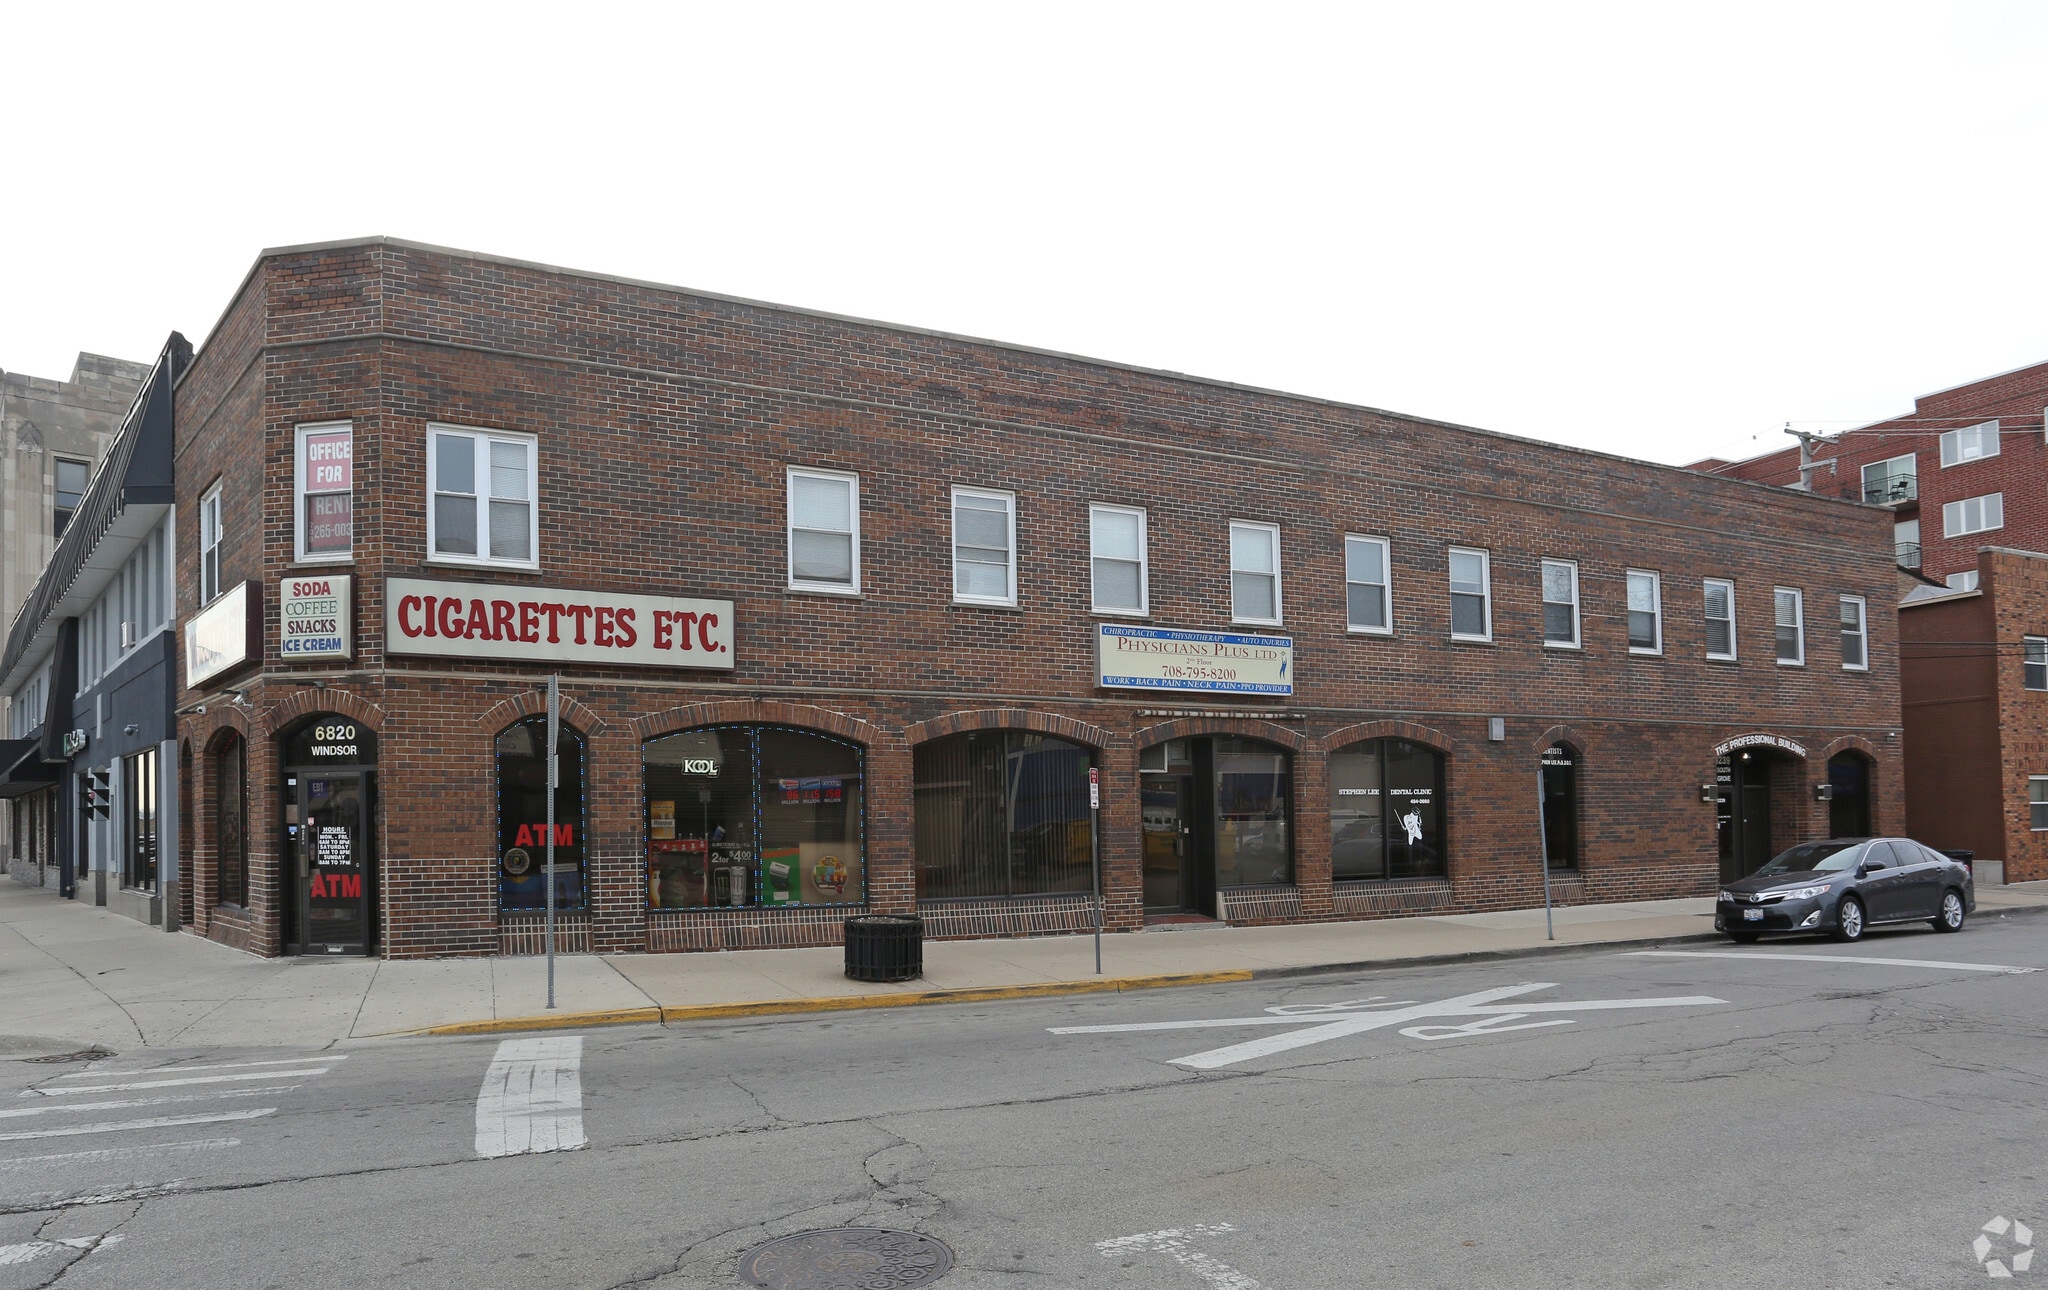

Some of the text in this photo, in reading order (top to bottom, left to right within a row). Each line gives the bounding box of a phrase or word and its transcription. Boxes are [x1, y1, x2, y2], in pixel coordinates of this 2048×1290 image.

[309, 440, 351, 461] OFFICE
[316, 465, 342, 483] FOR
[315, 495, 351, 515] RENT
[293, 581, 331, 597] SODA
[285, 600, 338, 616] COFFEE
[287, 619, 336, 635] SNACKS
[397, 594, 727, 653] CIGARETTES ETC.
[282, 637, 342, 652] ICE CREAM
[1104, 627, 1290, 647] CHIROPRACTIC PHYSIOTHERAPY AUTO INJURIES
[1117, 637, 1277, 660] PHYSICIANS PLUS LTD
[1196, 658, 1213, 666] Floor
[1162, 665, 1236, 681] 708-795-8200
[1106, 676, 1131, 685] WORK
[1136, 678, 1158, 687] BACK
[1187, 680, 1212, 689] NECK
[1215, 682, 1236, 690] PAIN
[1254, 684, 1288, 692] PROVIDER
[315, 725, 356, 741] 6820
[311, 745, 358, 756] WINDSOR
[1714, 735, 1807, 757] THE PROFESSIONAL BUILDING
[684, 759, 719, 774] KOOL
[514, 823, 574, 847] ATM
[310, 873, 362, 898] ATM
